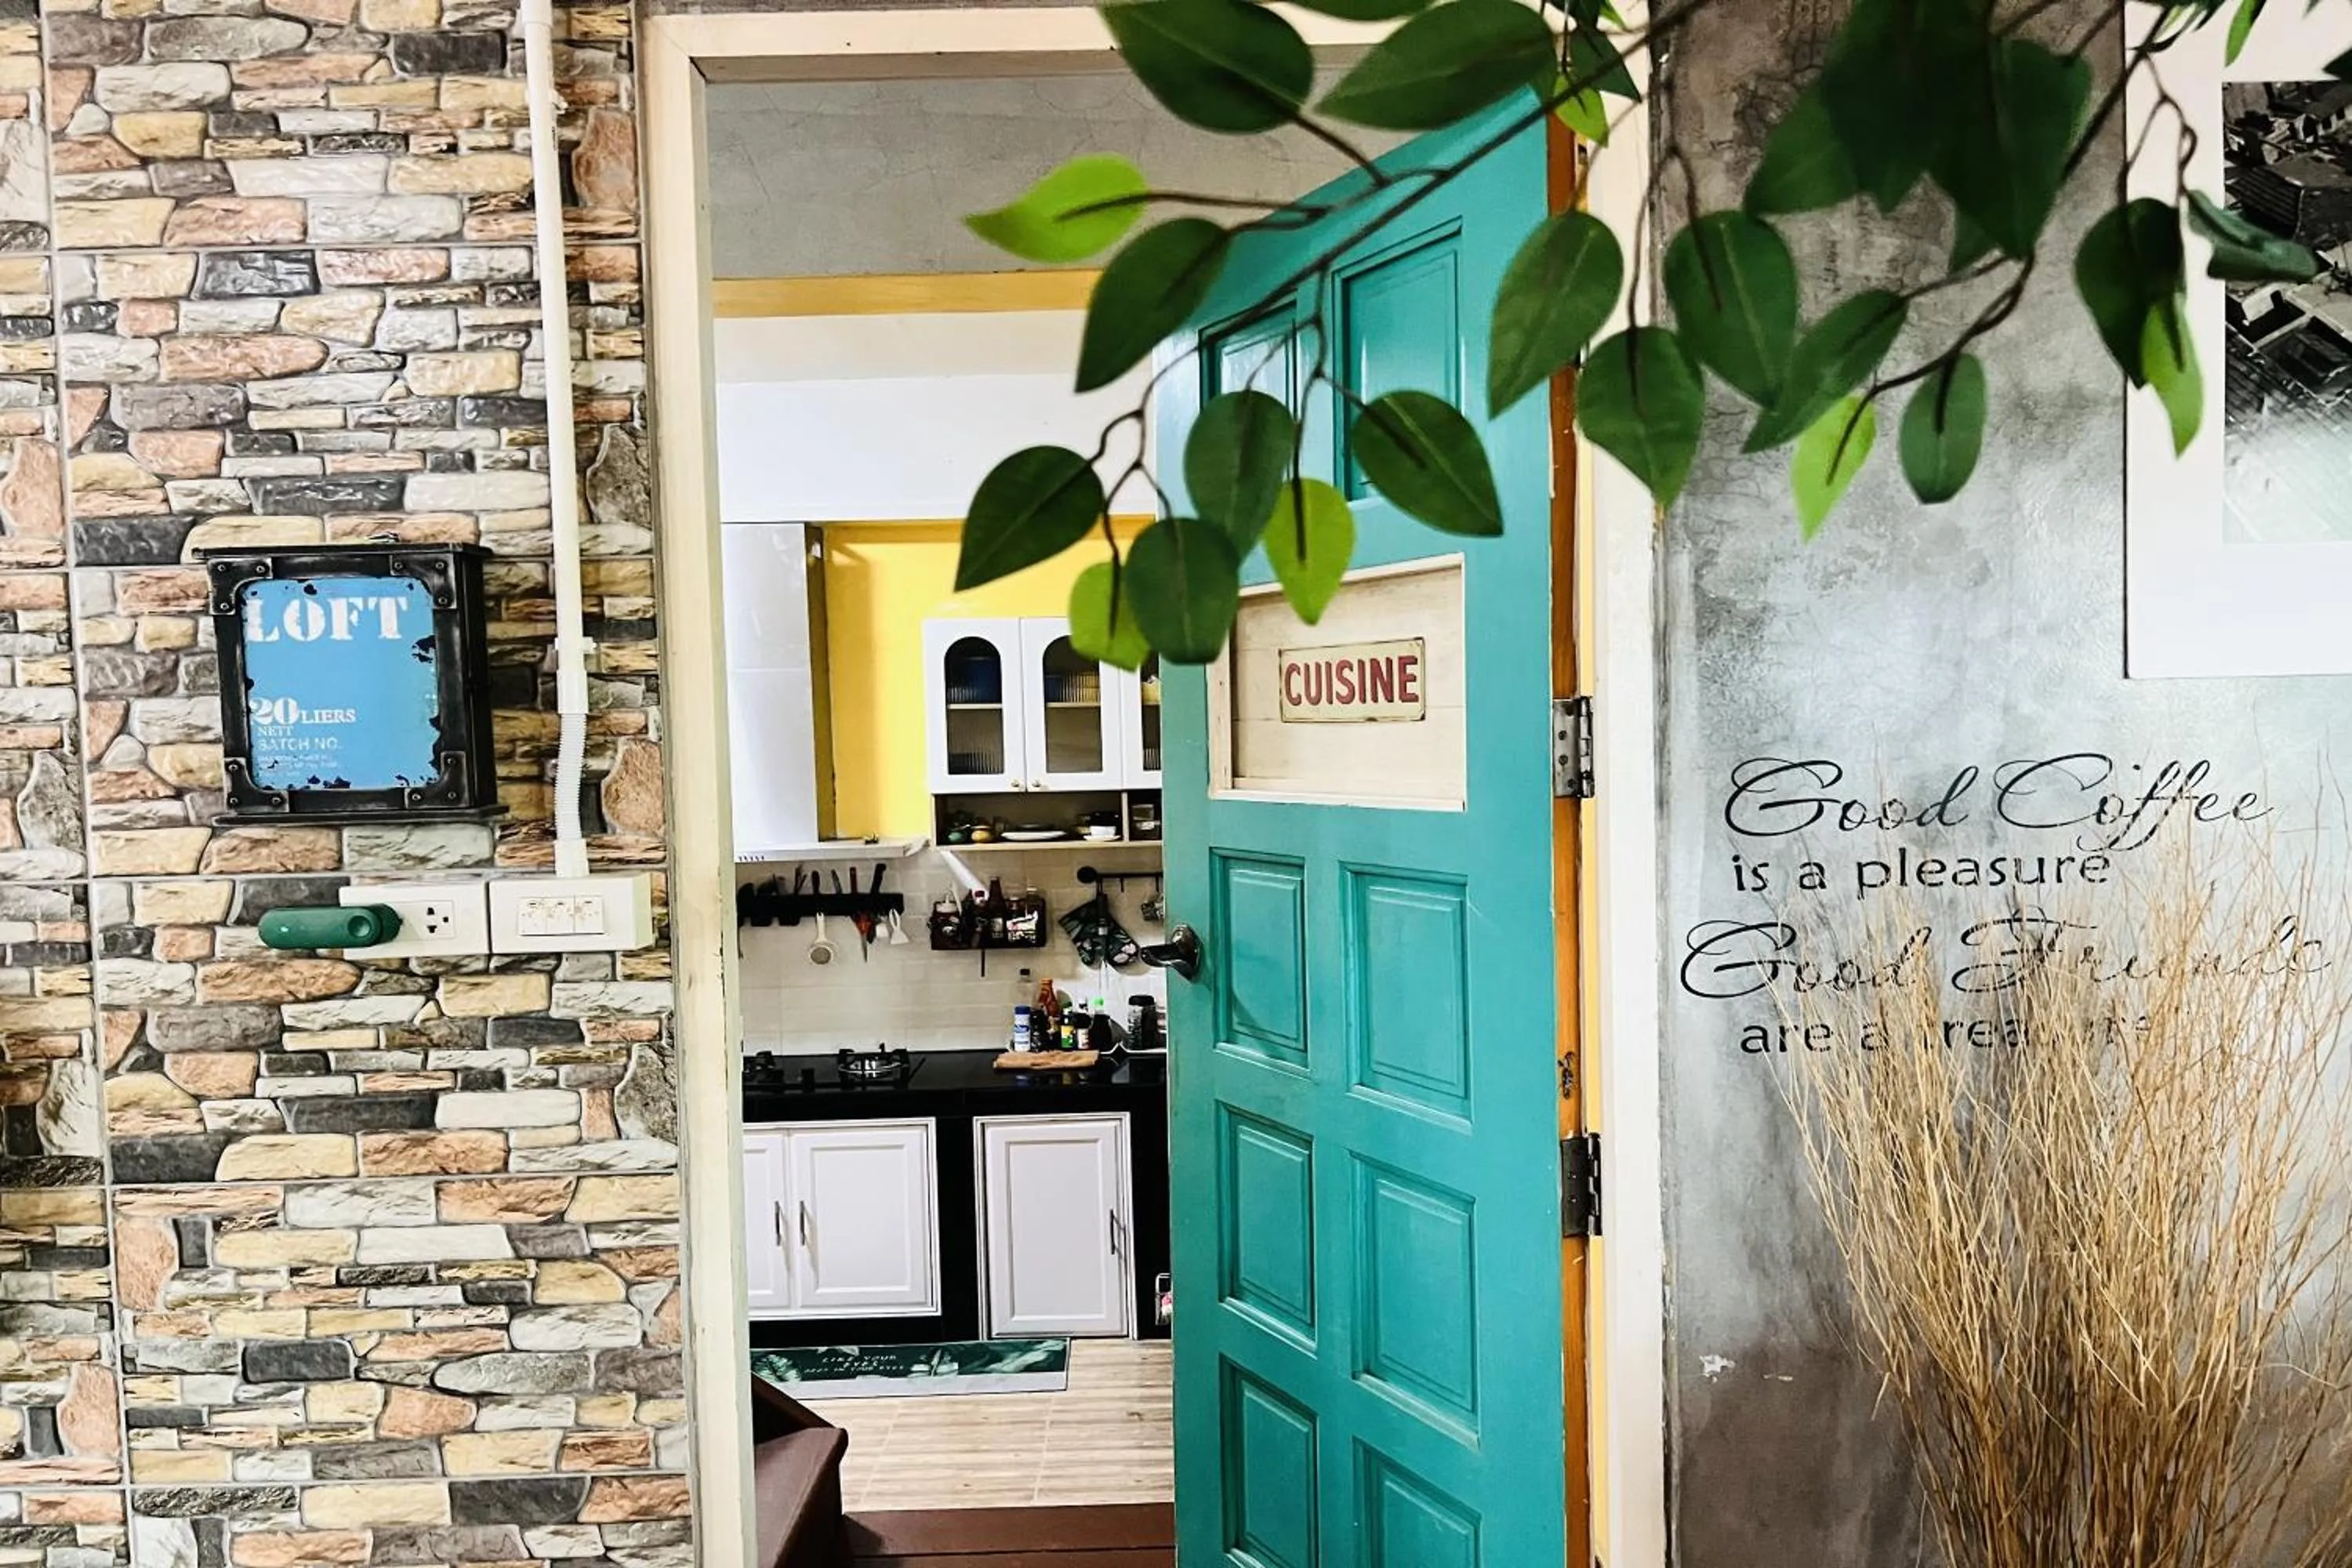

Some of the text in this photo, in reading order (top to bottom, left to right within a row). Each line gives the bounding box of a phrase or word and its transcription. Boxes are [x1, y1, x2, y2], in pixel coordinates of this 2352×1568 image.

[245, 596, 408, 641] LOFT
[1284, 655, 1420, 706] CUISINE
[249, 697, 299, 725] 20
[1725, 753, 2274, 852] Good Coffee
[1732, 847, 2110, 901] is a pleasure
[1680, 920, 1933, 999] Good
[1740, 1022, 1834, 1054] are
